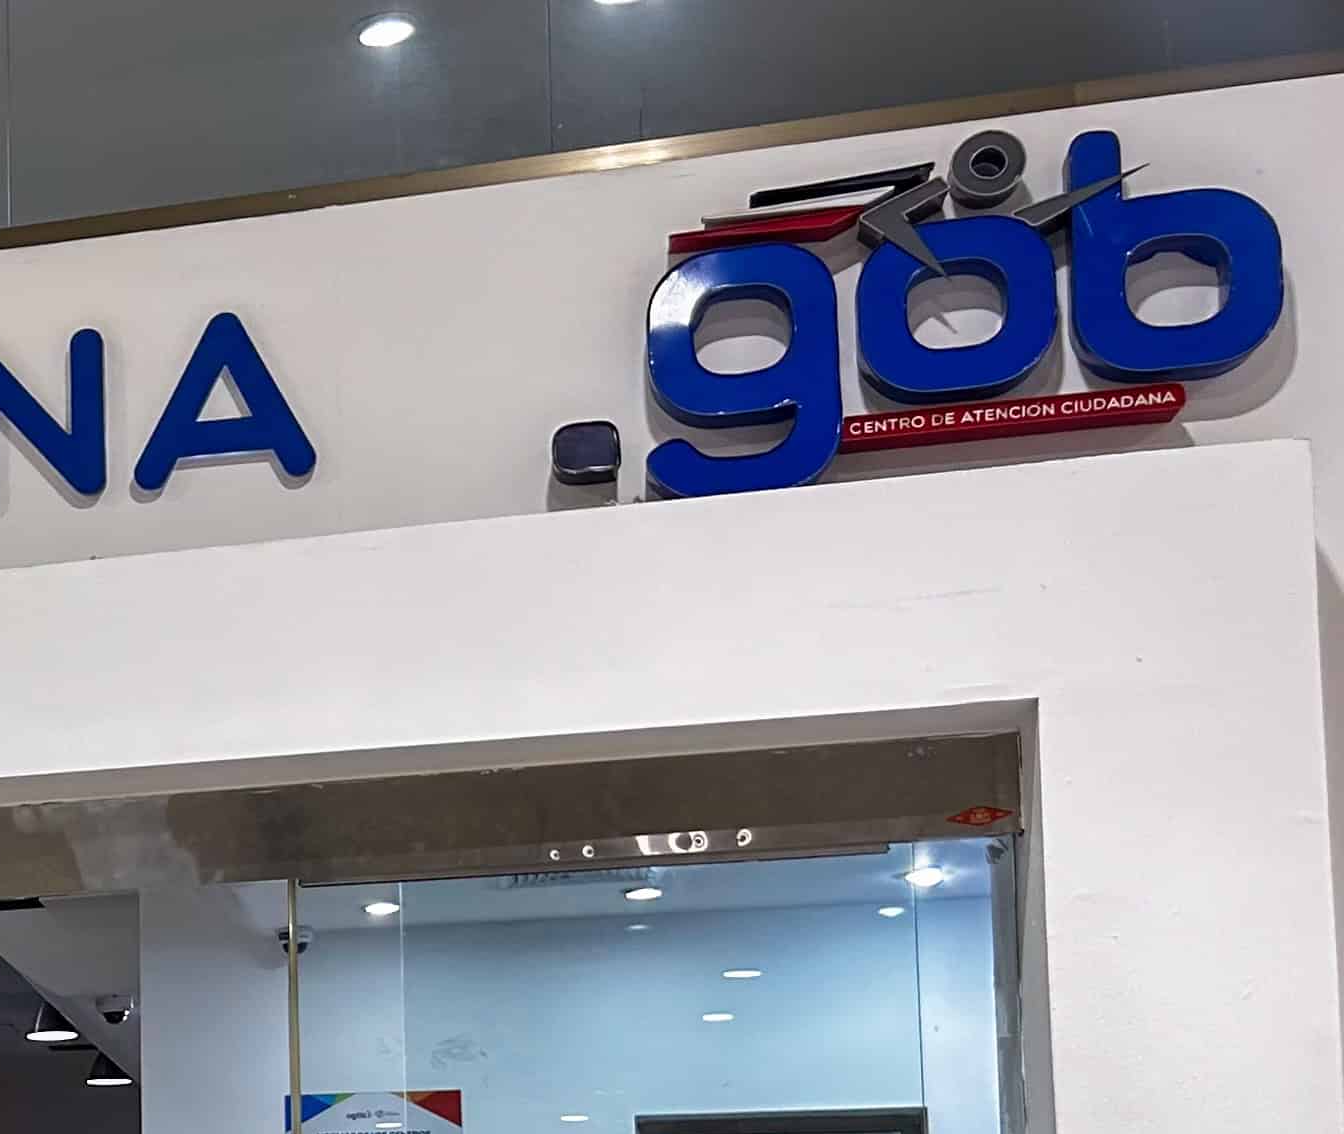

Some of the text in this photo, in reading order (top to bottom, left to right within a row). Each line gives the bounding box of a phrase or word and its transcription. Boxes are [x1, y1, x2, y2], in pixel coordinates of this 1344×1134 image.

[849, 390, 1177, 435] CENTRO DE ATENCIÓN CIUDADANA
